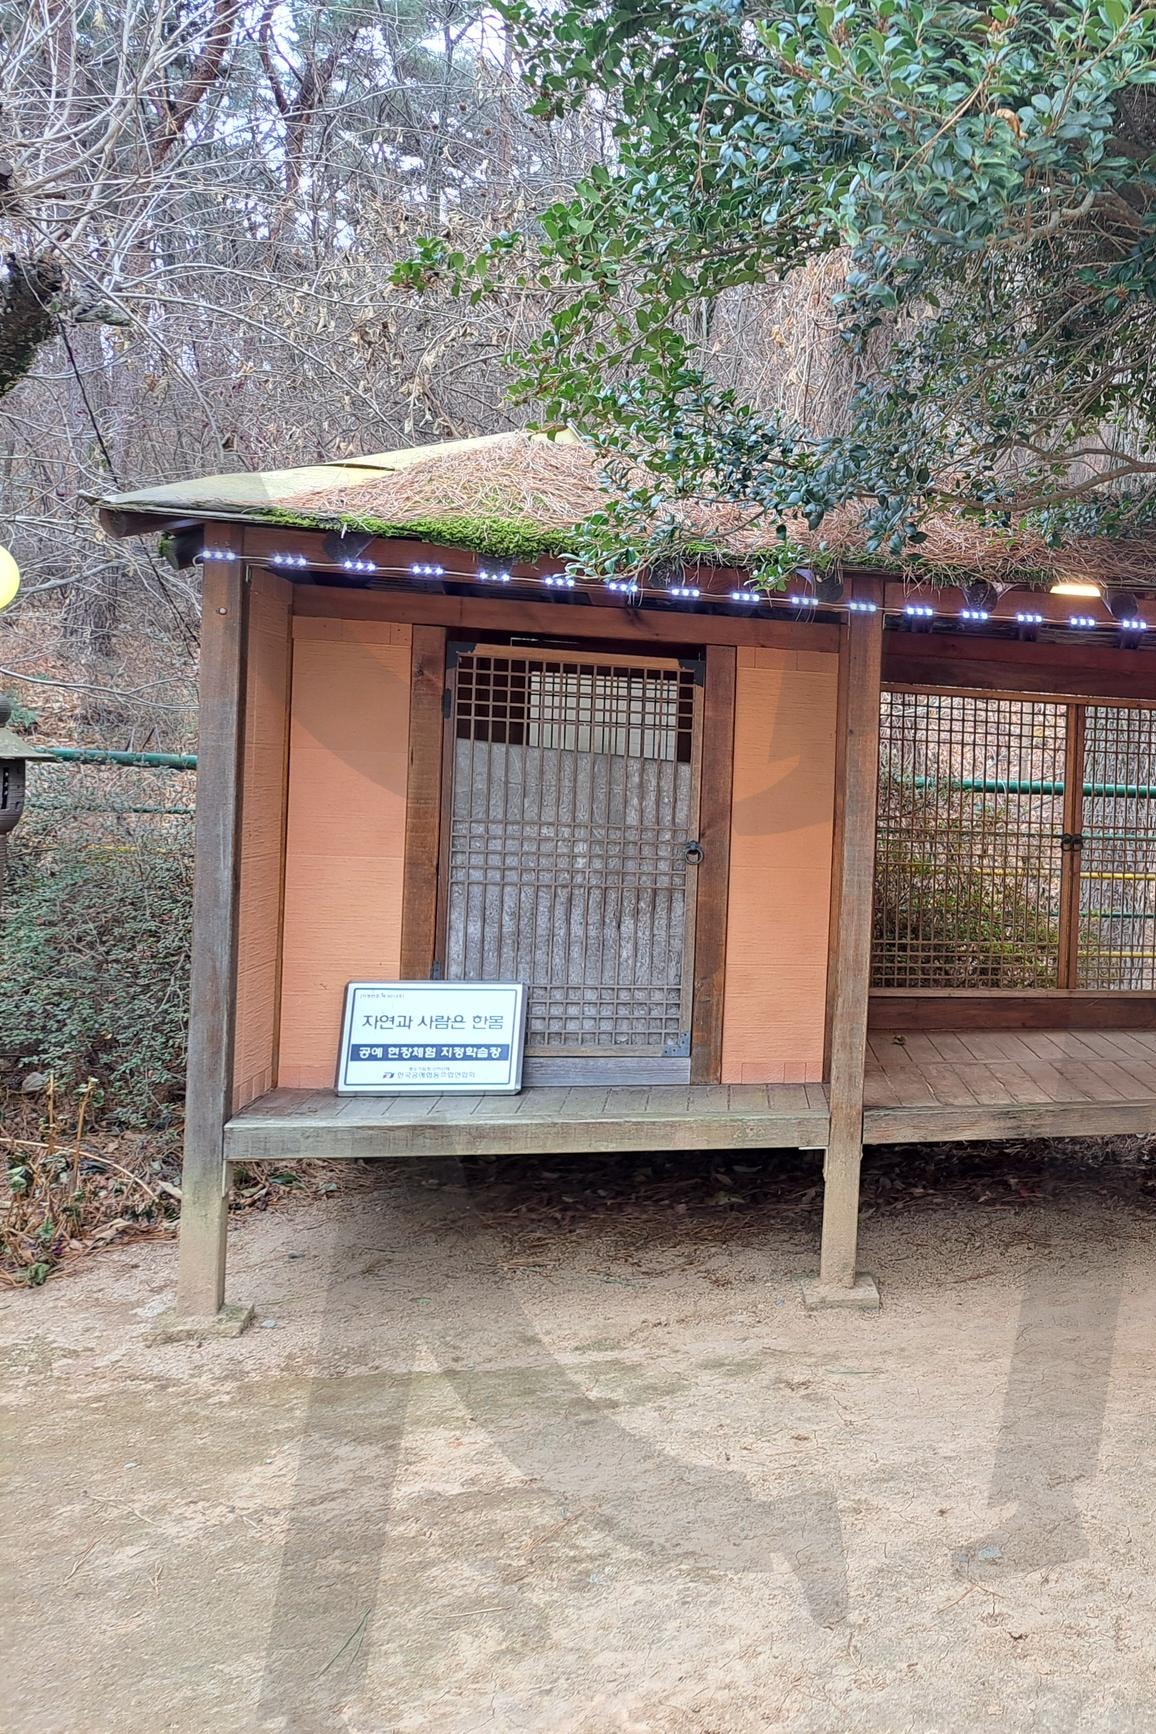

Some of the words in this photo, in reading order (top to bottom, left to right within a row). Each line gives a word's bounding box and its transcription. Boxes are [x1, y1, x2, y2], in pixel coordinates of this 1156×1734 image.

[362, 1014, 414, 1030] 자연과
[417, 1014, 467, 1030] 사람은
[472, 1014, 504, 1030] 한몸
[358, 1046, 383, 1059] 공예
[387, 1046, 437, 1059] 현장체험
[440, 1046, 502, 1059] 지정학습장
